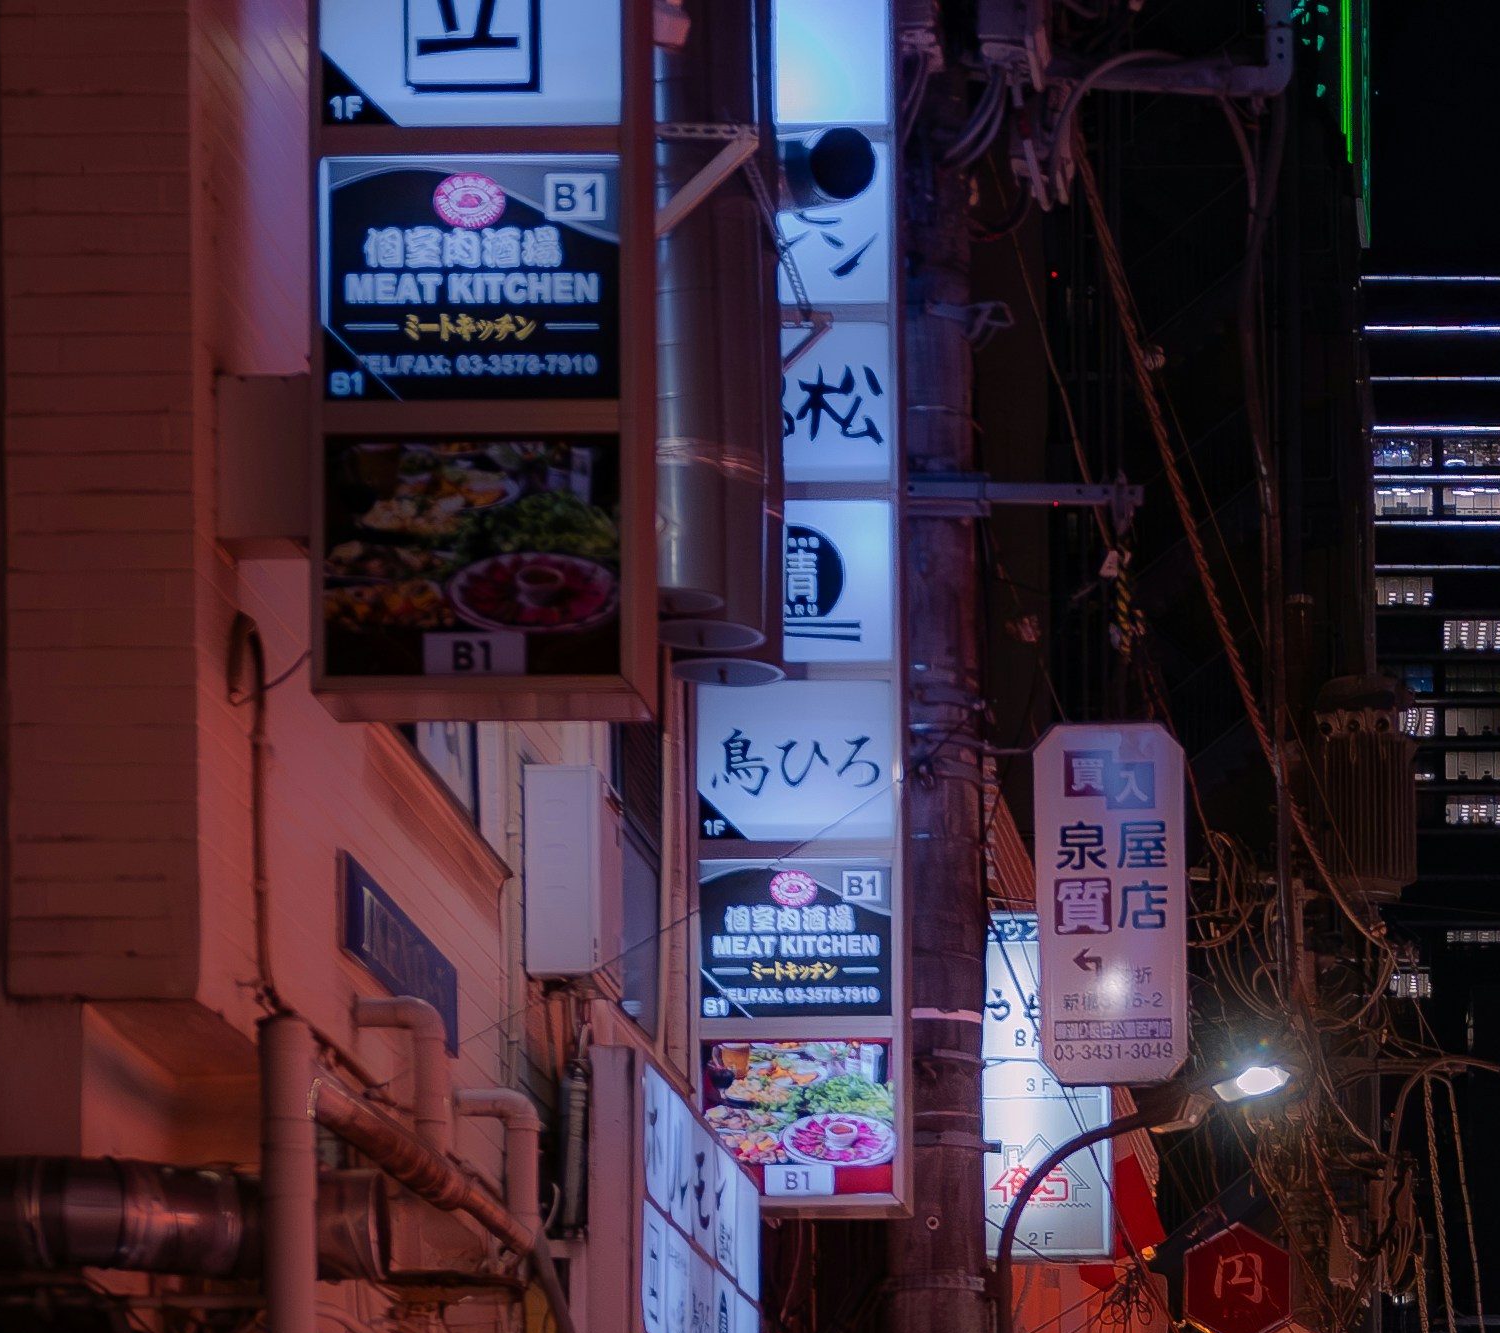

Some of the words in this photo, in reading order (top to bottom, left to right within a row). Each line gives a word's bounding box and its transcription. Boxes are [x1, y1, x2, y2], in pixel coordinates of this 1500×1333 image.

[330, 96, 363, 120] 1F
[555, 183, 597, 212] B1
[364, 226, 562, 268] 個室肉酒場
[344, 273, 443, 304] MEAT
[447, 273, 599, 303] KITCHEN
[404, 314, 535, 341] ミートキッチン
[330, 371, 365, 395] B1
[452, 641, 492, 671] B1
[711, 727, 881, 797] 鳥ひろ
[703, 819, 726, 836] 1F
[1056, 820, 1168, 871] 泉屋
[847, 875, 877, 897] B1
[1055, 878, 1168, 934] 質店
[725, 905, 856, 933] 個室肉酒場
[712, 935, 777, 958] MEAT
[779, 934, 880, 957] KITCHEN
[752, 961, 838, 981] ミートキッチン
[785, 986, 881, 1003] 03-3578-7910
[703, 997, 729, 1017] B1
[1053, 1042, 1174, 1062] 03-3431-3049
[1026, 1077, 1052, 1093] 3F
[784, 1170, 813, 1191] B1
[1028, 1232, 1054, 1246] 2F
